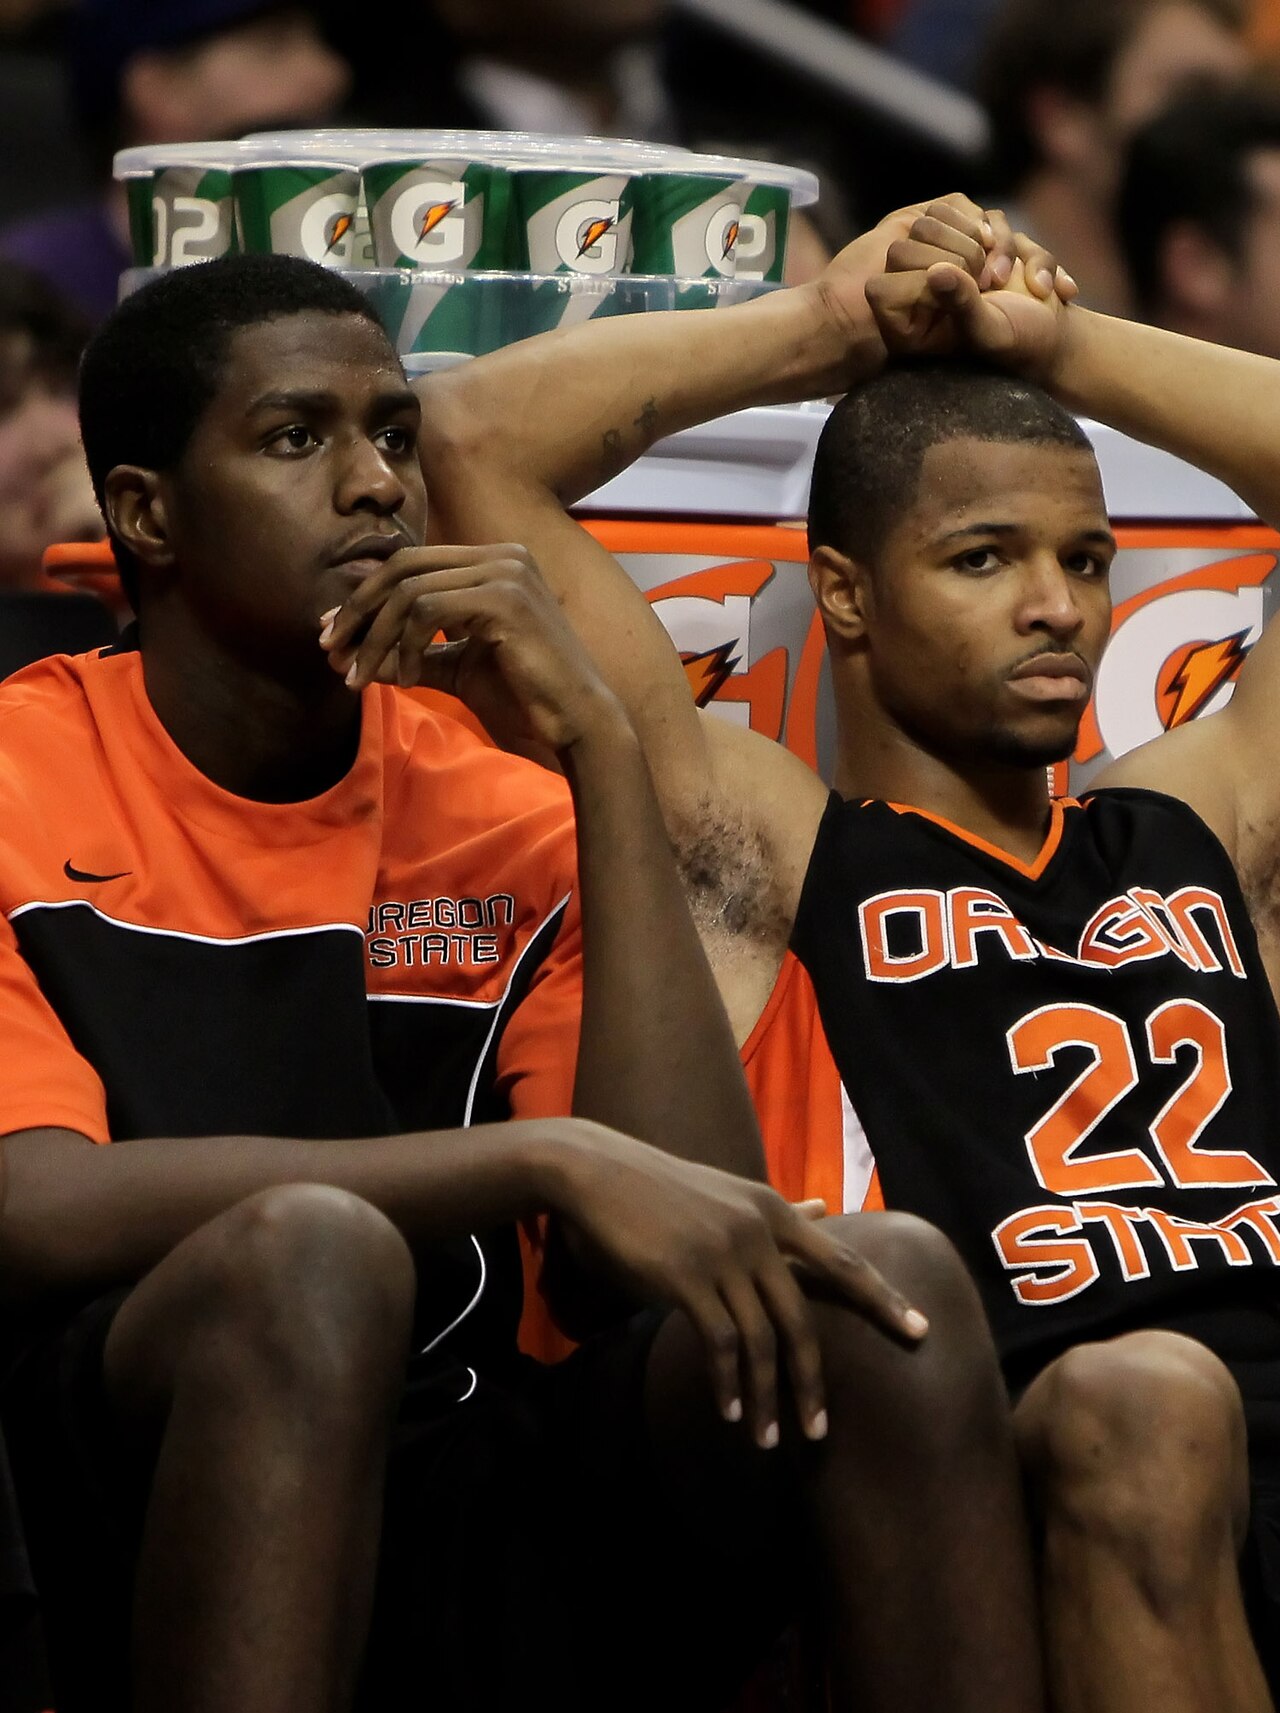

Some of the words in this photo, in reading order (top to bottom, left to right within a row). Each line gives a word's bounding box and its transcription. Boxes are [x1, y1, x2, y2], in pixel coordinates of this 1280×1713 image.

[390, 180, 466, 264] G
[558, 199, 620, 274] G
[367, 932, 500, 969] STATE
[1005, 997, 1278, 1197] 22
